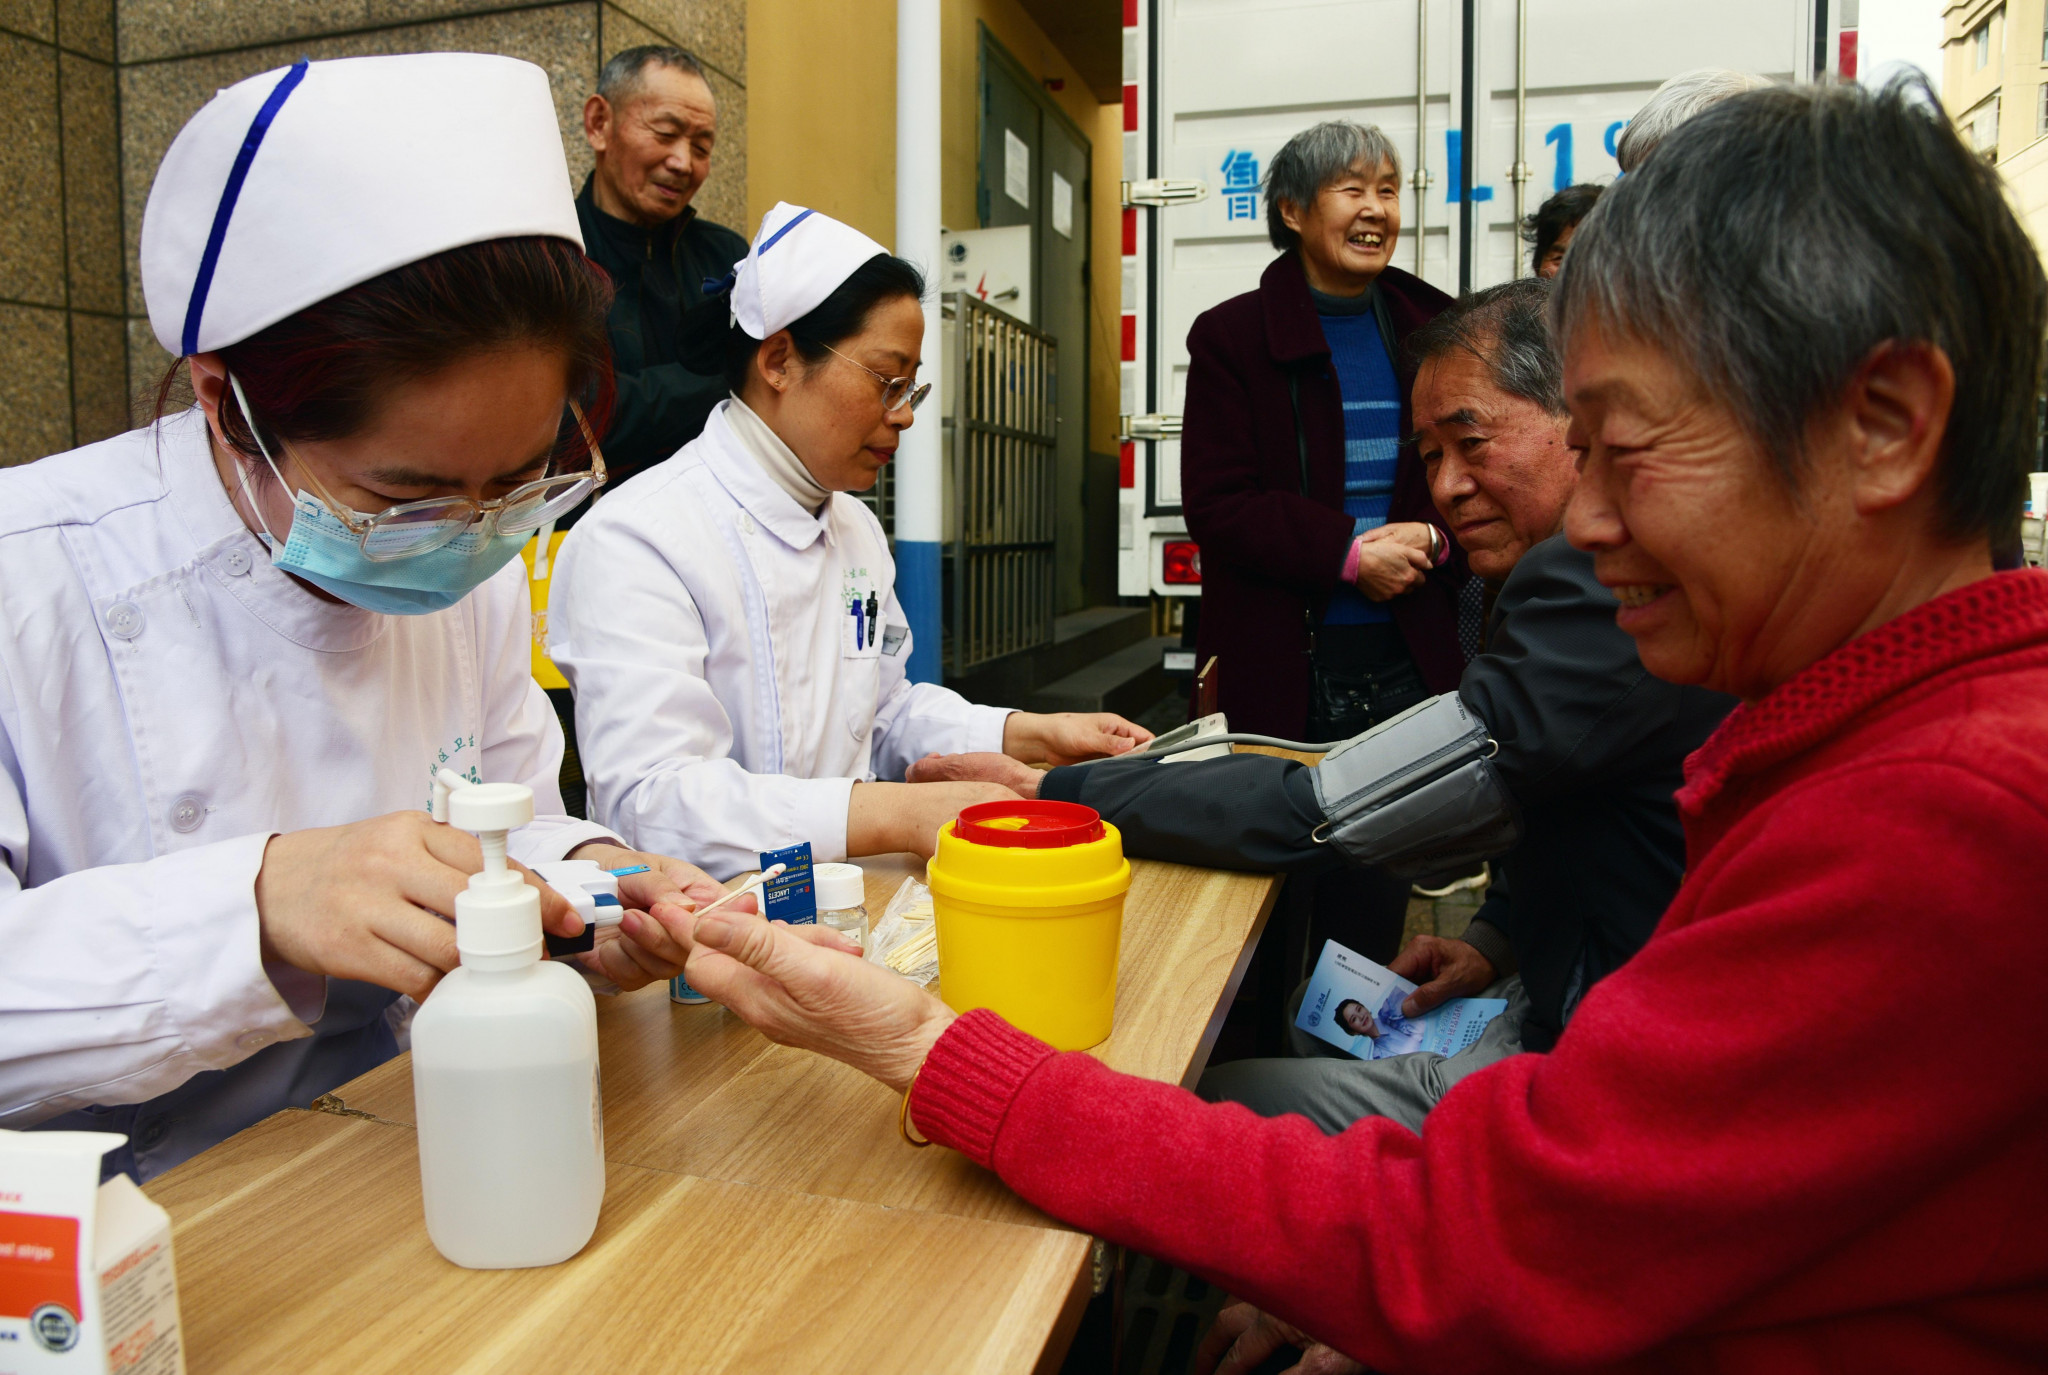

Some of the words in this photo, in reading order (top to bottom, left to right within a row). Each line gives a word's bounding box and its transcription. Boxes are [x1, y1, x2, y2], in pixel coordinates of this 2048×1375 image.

[1220, 149, 1262, 221] 鲁
[767, 887, 790, 900] LANCETS
[17, 1244, 55, 1263] strips
